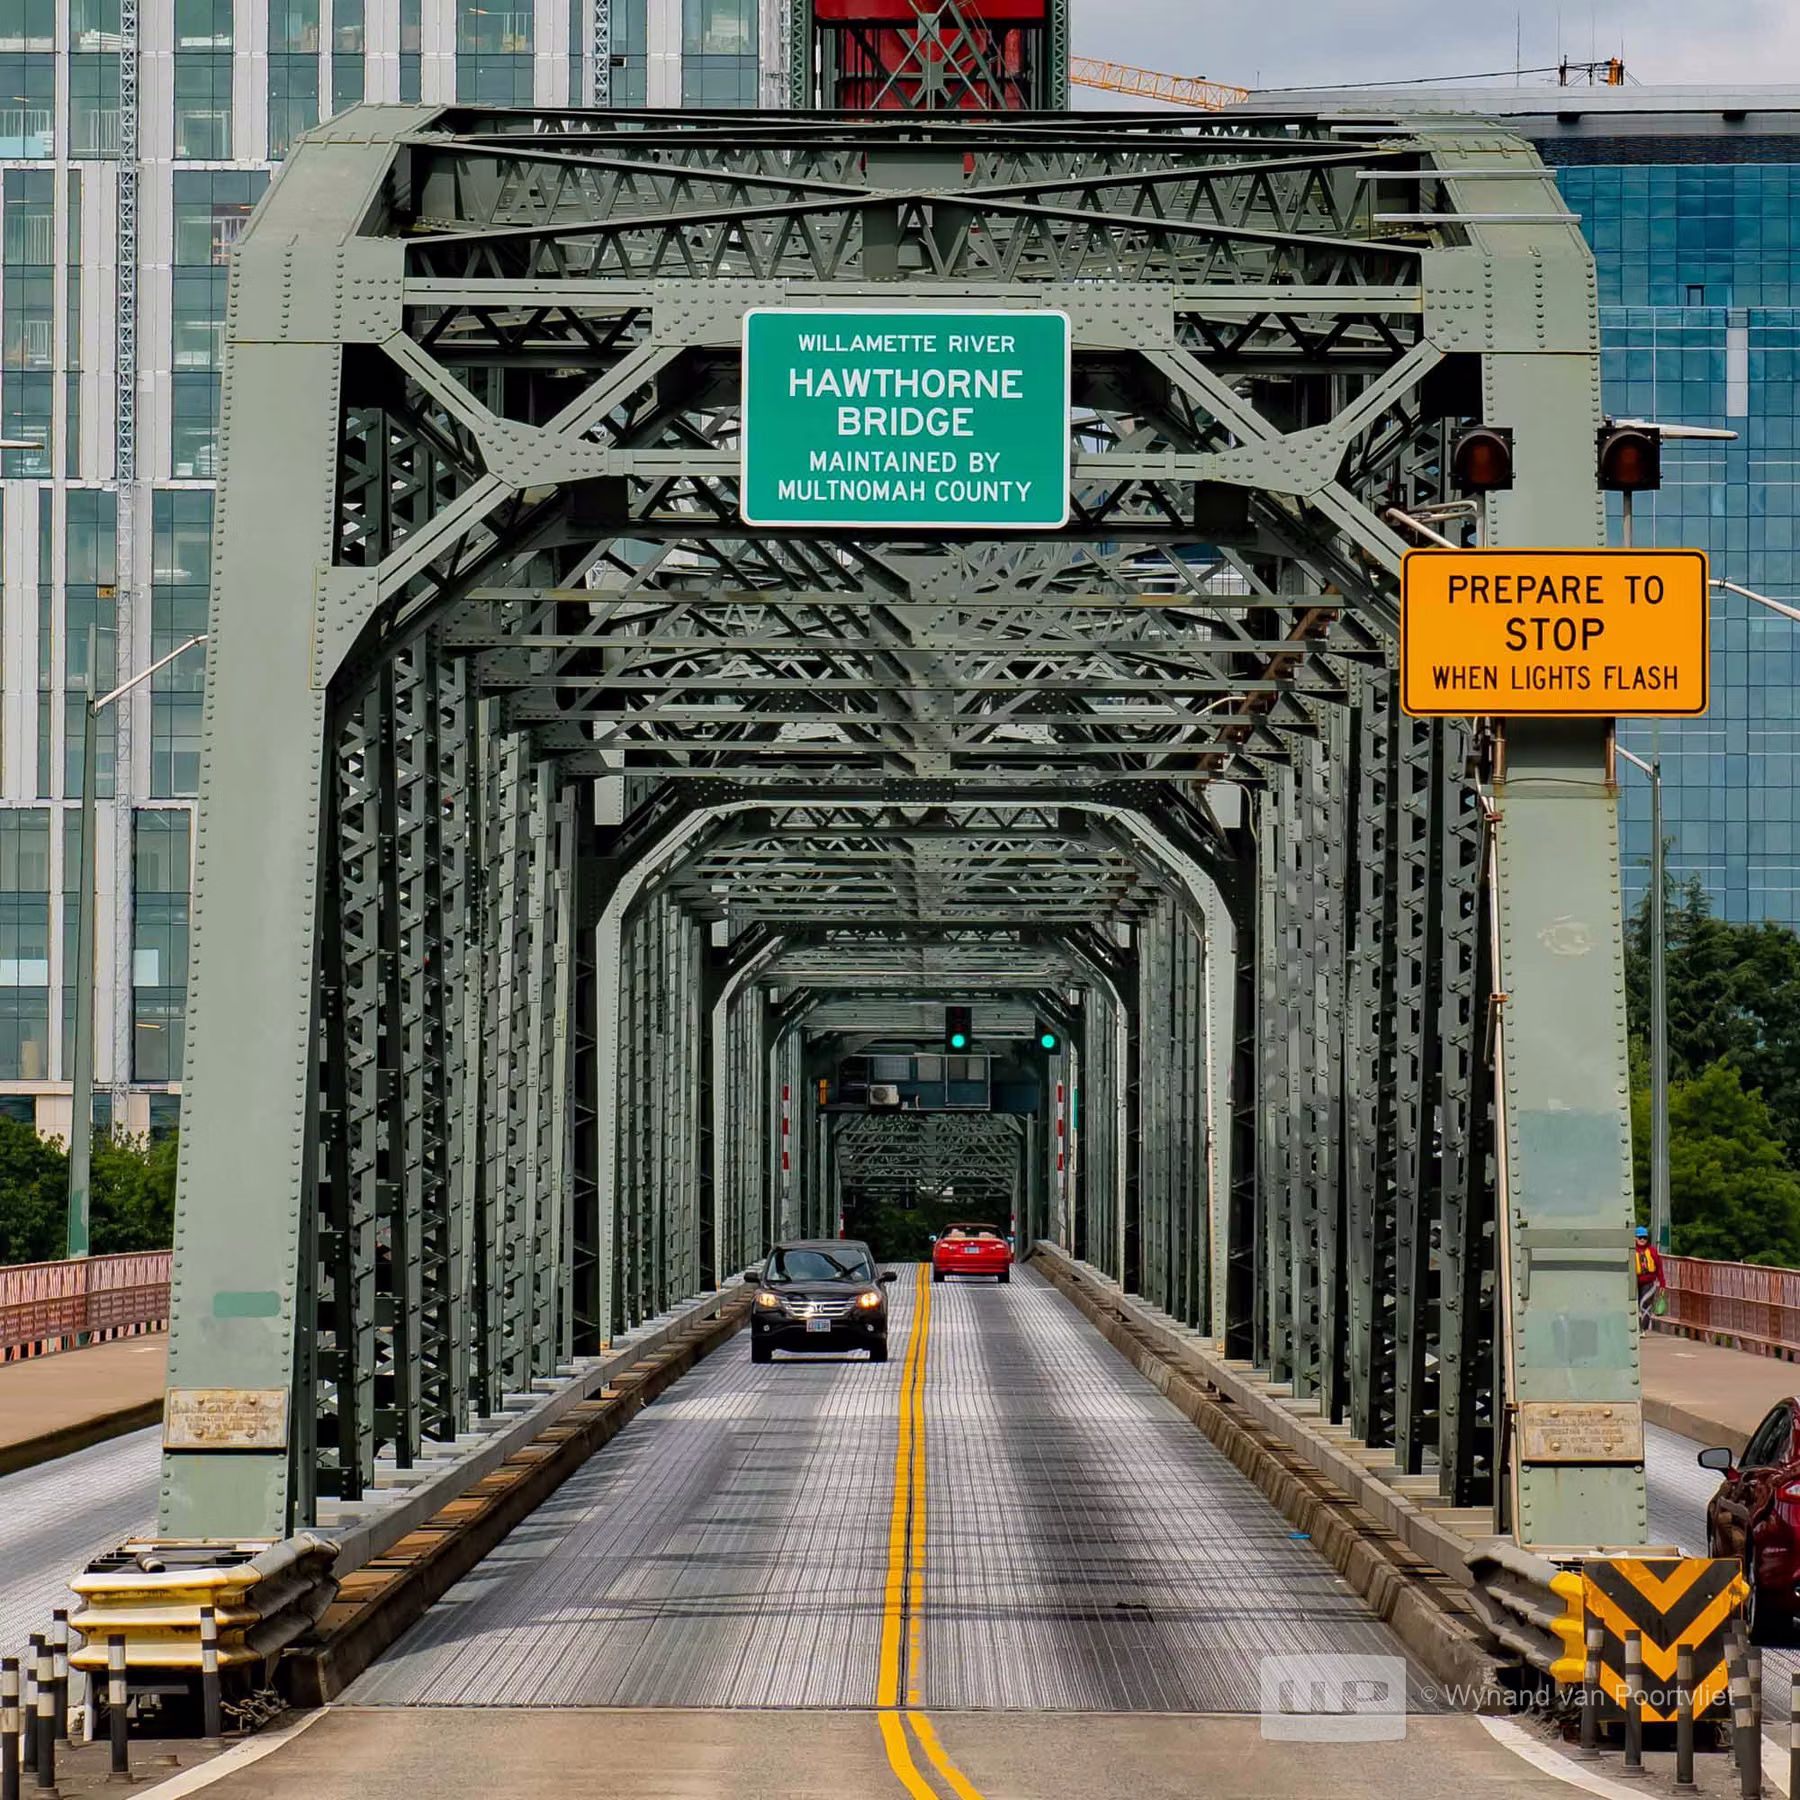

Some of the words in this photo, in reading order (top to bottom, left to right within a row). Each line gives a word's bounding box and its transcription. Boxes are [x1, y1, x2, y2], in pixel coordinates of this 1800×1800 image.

[798, 334, 937, 353] WILLAMETTE
[949, 335, 1015, 353] RIVER
[789, 368, 1023, 399] HAWTHORNE
[837, 406, 974, 437] BRIDGE
[809, 450, 957, 473] MAINTAINED
[969, 451, 1001, 473] BY
[778, 479, 925, 502] MULTNOMAH
[935, 480, 1032, 502] COUNTY
[1448, 575, 1604, 604] PREPARE
[1624, 575, 1664, 605] TO
[1505, 617, 1605, 652] STOP
[1432, 665, 1498, 690] WHEN
[1511, 665, 1591, 691] LIGHTS
[1604, 665, 1678, 690] FLASH
